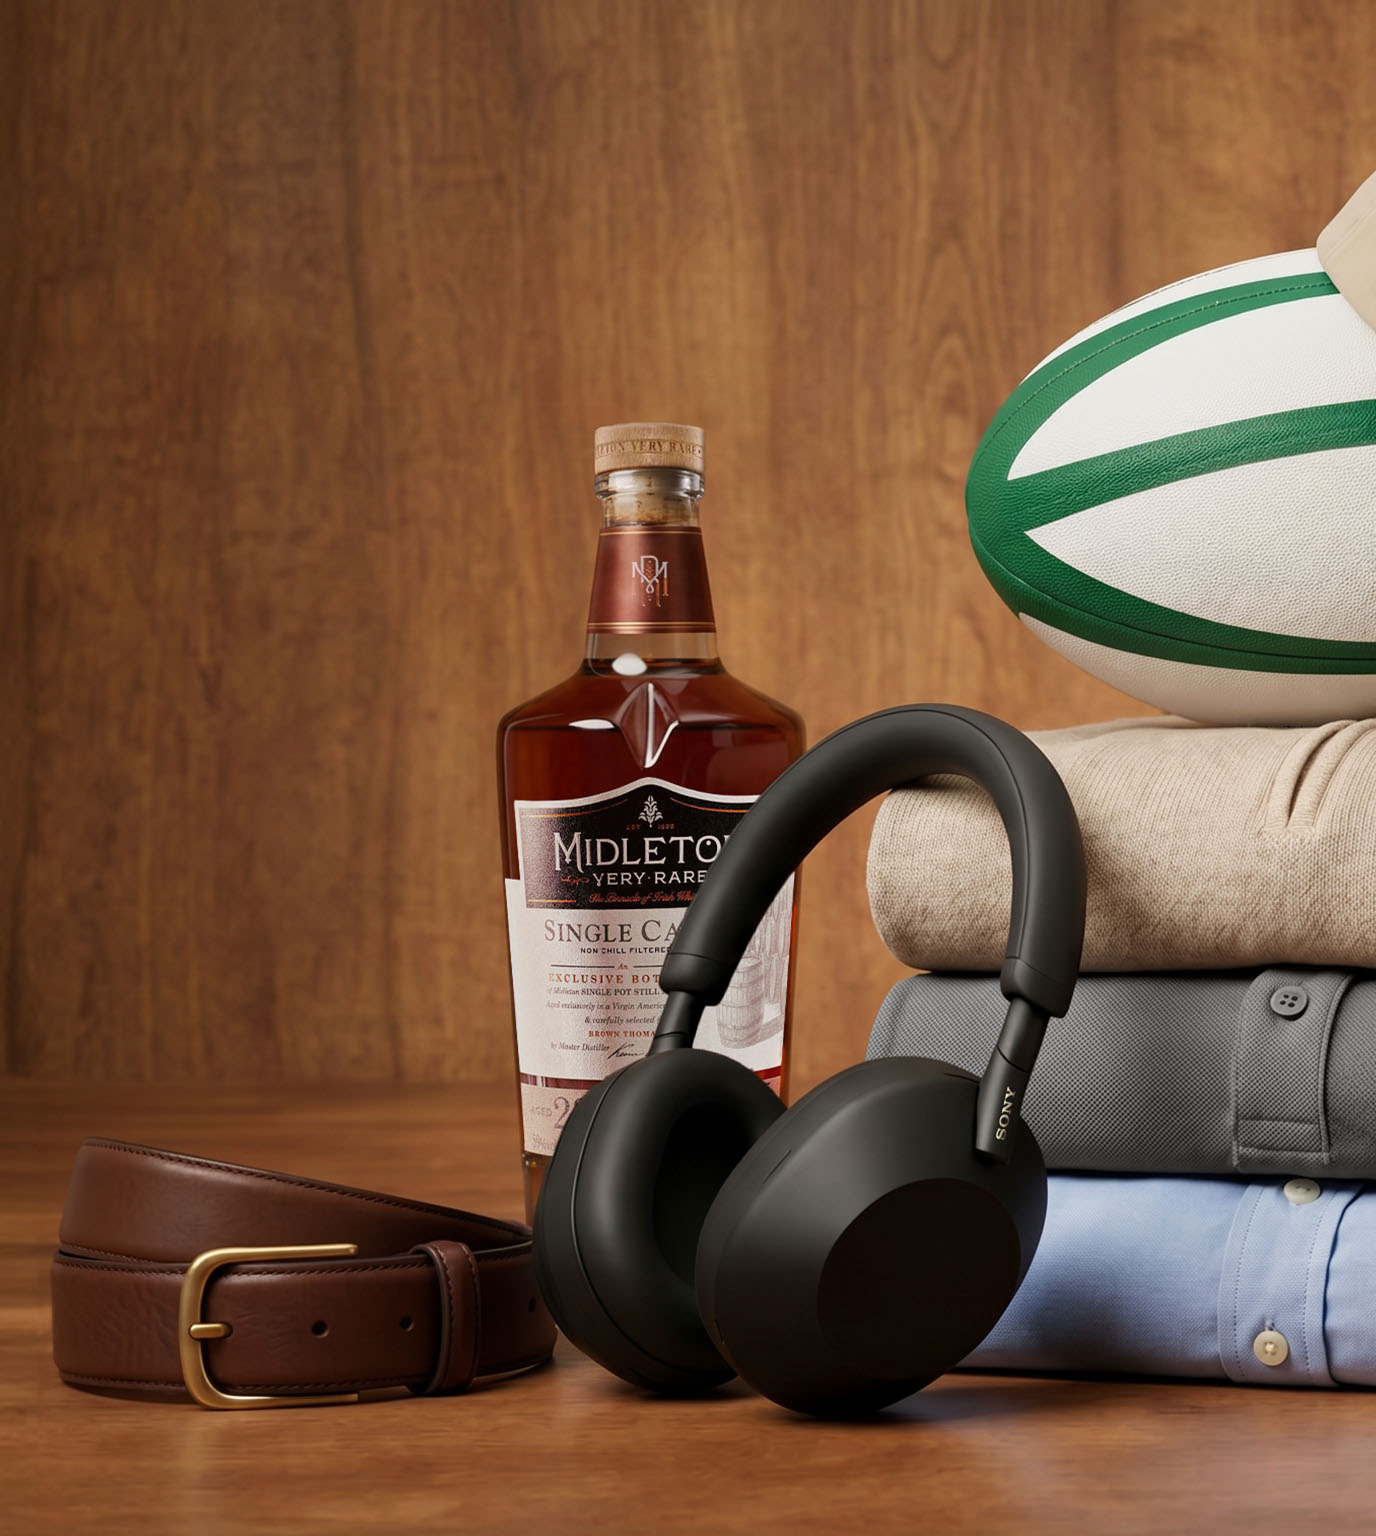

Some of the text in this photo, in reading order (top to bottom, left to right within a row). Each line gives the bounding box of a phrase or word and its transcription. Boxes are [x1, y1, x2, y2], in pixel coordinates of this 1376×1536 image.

[544, 919, 681, 942] SINGLE CA
[548, 973, 660, 984] EXCLUSIVE BOT
[581, 987, 612, 996] SINGLE
[614, 987, 632, 996] POT
[634, 987, 660, 996] STILL
[638, 1001, 665, 1010] Americ
[588, 1030, 656, 1038] BROWN THOMA
[995, 1086, 1016, 1141] SONY
